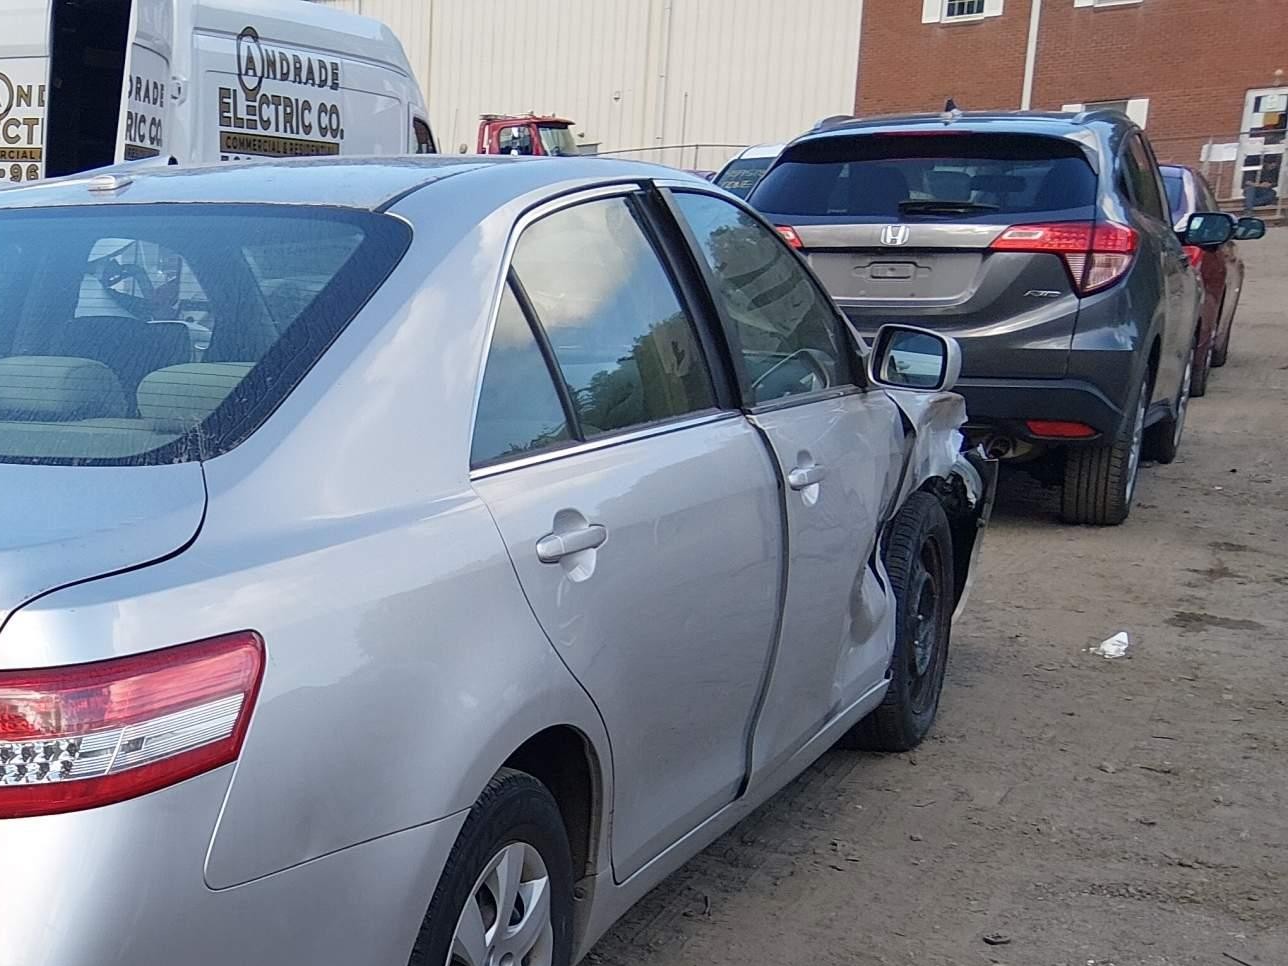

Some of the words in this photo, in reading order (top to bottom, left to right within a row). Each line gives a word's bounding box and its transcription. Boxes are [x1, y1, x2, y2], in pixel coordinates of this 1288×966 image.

[245, 46, 339, 91] ANDRADE
[219, 86, 312, 136] ELECTRIC
[317, 102, 344, 140] CO.
[225, 135, 281, 154] COMMERCIAL
